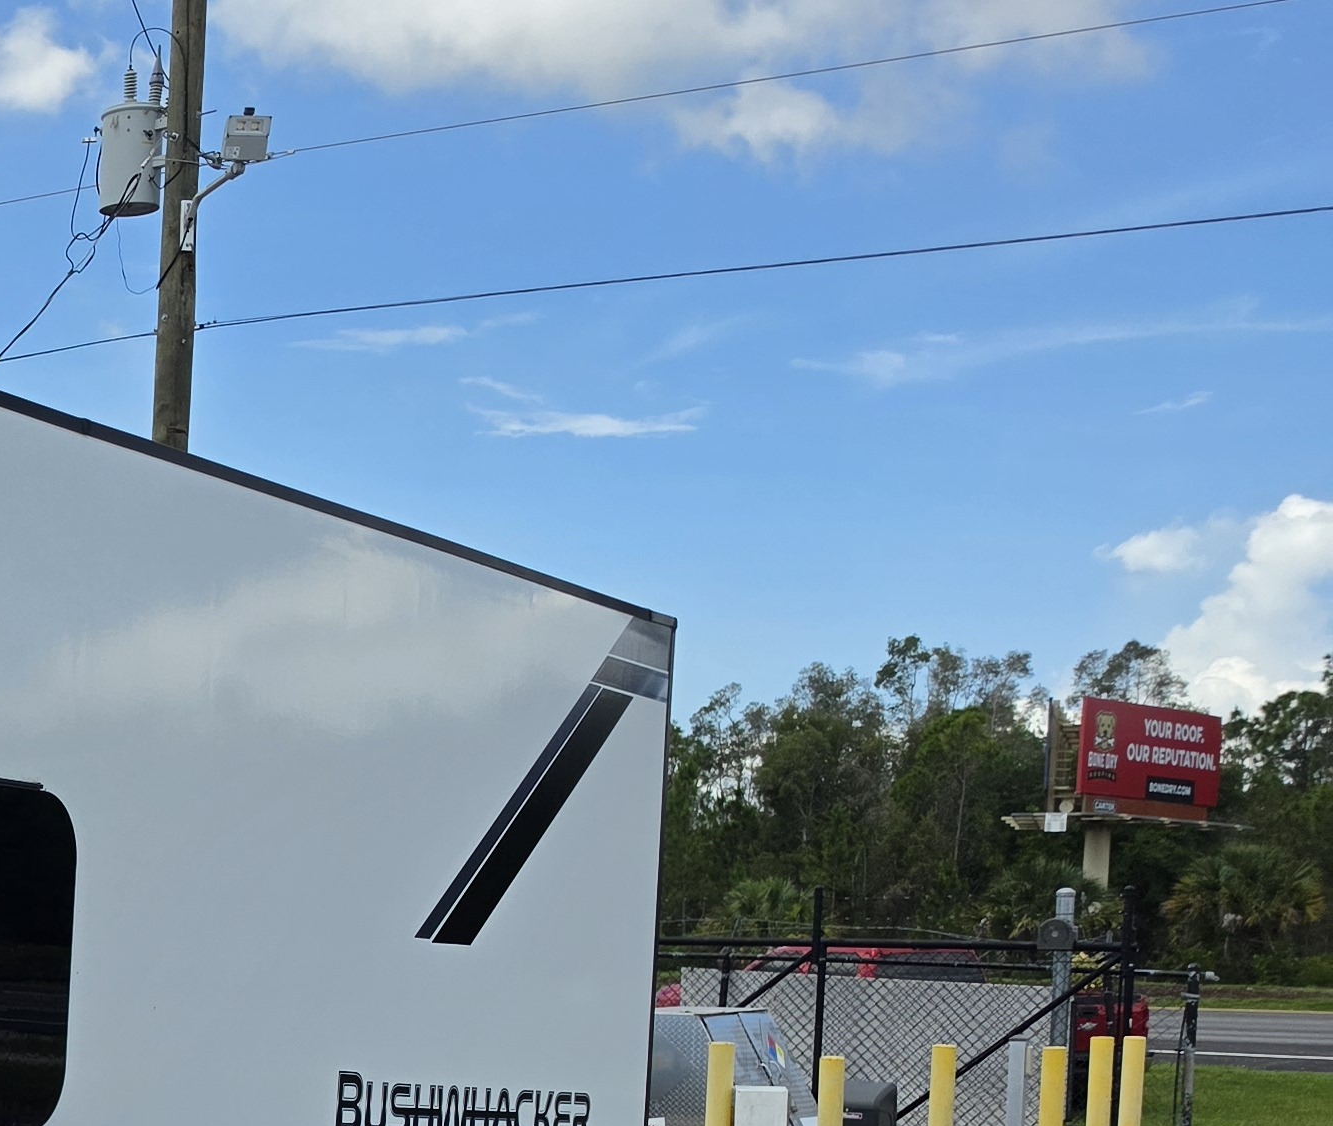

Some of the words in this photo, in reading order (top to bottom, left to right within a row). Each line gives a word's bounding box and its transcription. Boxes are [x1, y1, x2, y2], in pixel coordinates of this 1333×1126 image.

[1144, 718, 1172, 739] YOUR
[1174, 723, 1205, 744] ROOF.
[1127, 743, 1150, 763] OUR
[1151, 746, 1216, 771] REPUTATION.
